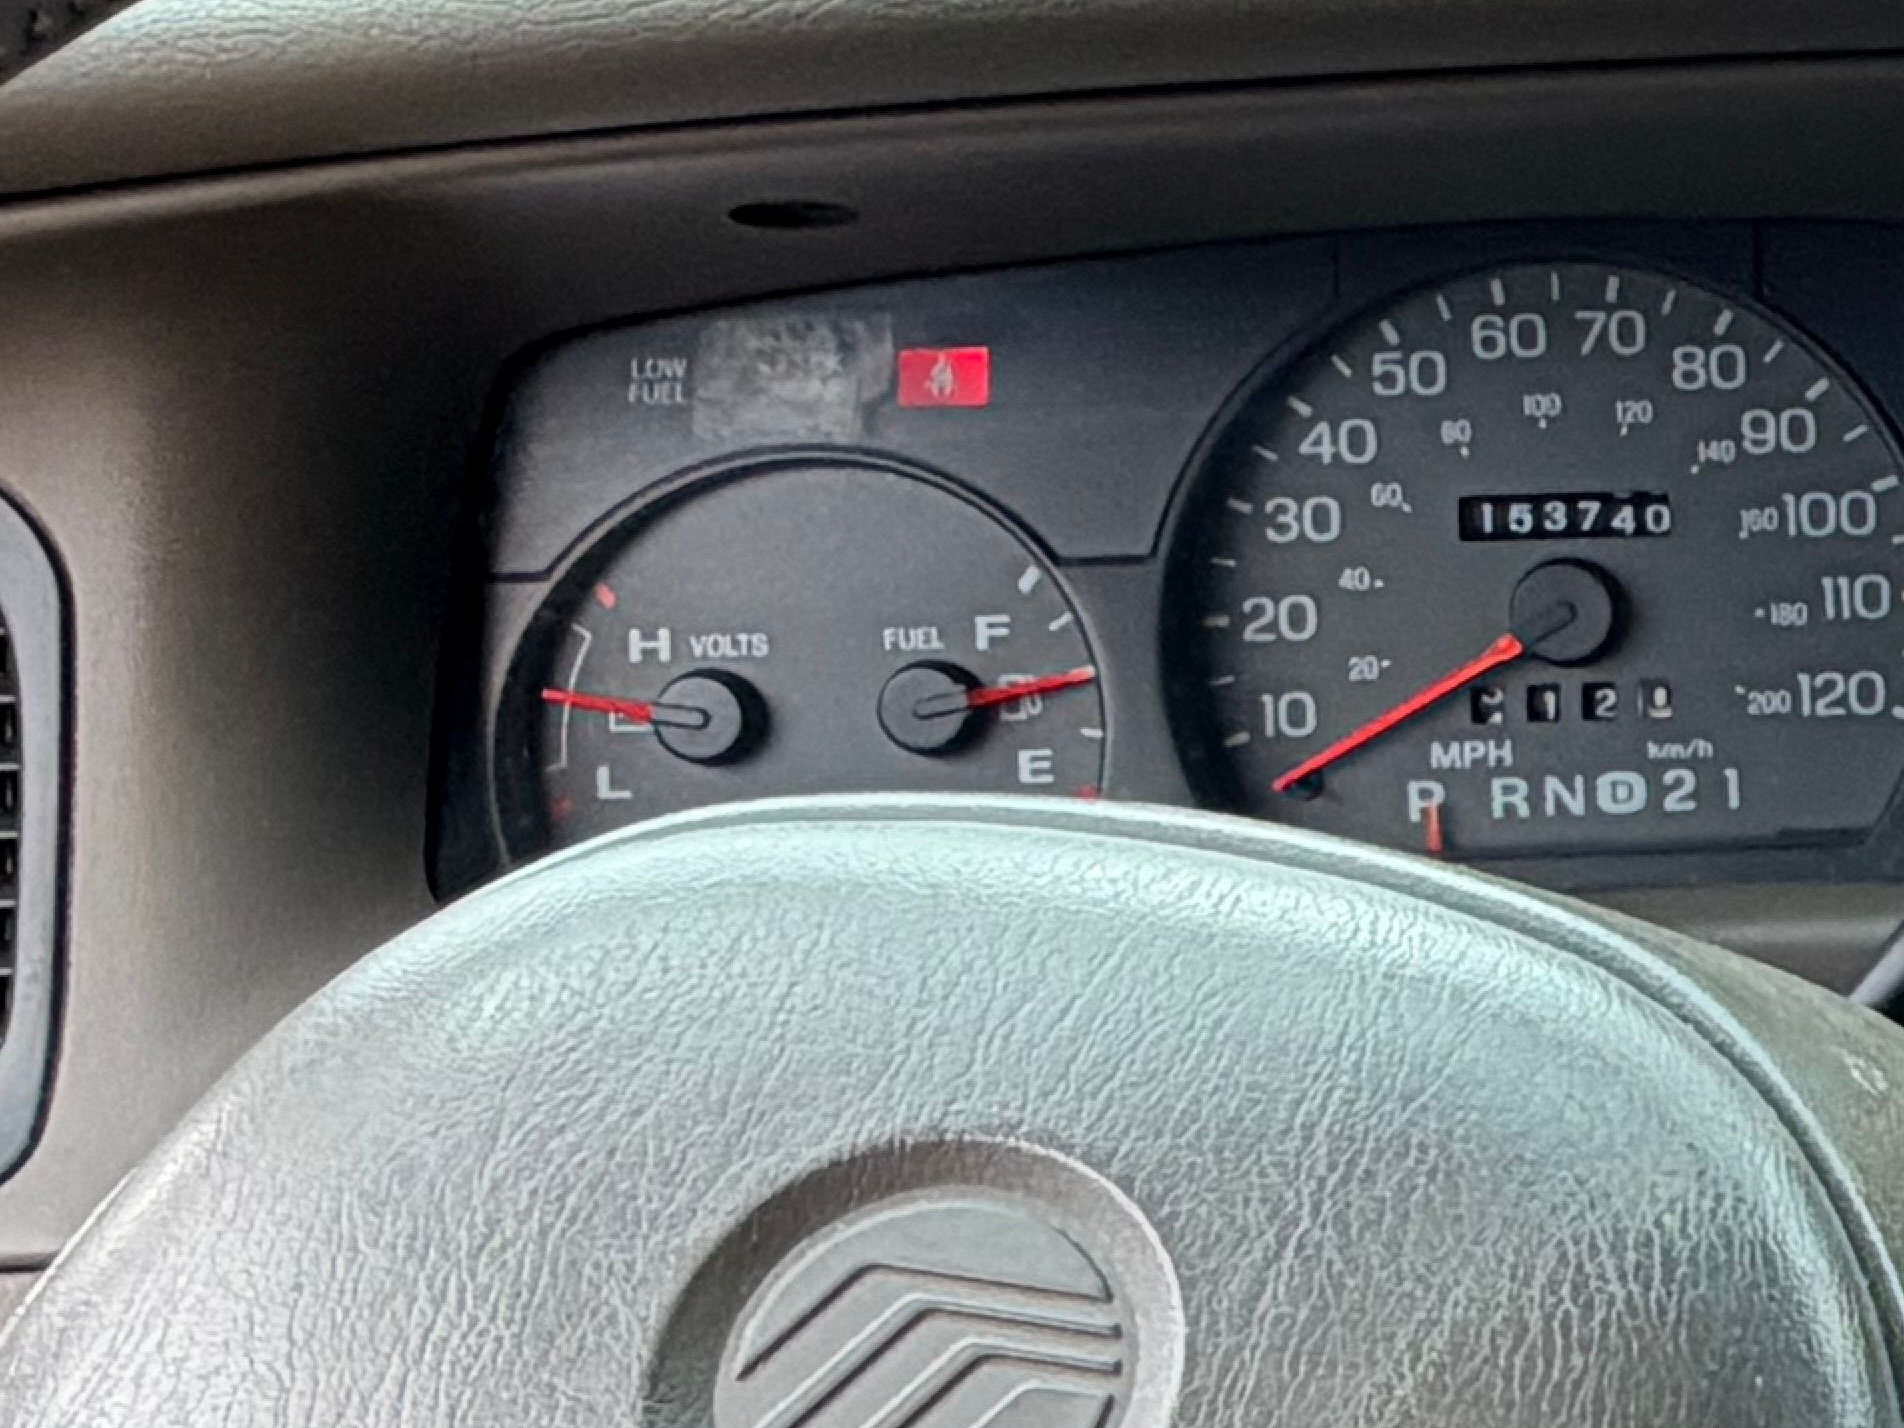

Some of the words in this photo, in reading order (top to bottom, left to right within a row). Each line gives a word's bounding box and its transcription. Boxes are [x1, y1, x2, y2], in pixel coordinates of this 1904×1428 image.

[1471, 314, 1545, 358] 60
[1576, 311, 1645, 355] 70
[631, 357, 687, 380] LOW
[1372, 351, 1445, 395] 50
[1672, 346, 1746, 390] 80
[629, 383, 687, 404] FUEL
[1523, 394, 1561, 417] 100
[1616, 401, 1652, 423] 120
[1300, 419, 1377, 464] 40
[1741, 409, 1816, 453] 90
[1699, 440, 1736, 462] 140
[1371, 485, 1401, 508] 60
[1265, 498, 1340, 543] 30
[1784, 491, 1877, 536] 100
[1338, 568, 1370, 590] 40
[1821, 575, 1890, 619] 110
[1242, 597, 1317, 641] 20
[1770, 603, 1807, 626] 180
[630, 630, 670, 661] H
[690, 632, 767, 657] VOLTS
[884, 627, 942, 651] FUEL
[975, 616, 1009, 650] F
[1348, 657, 1378, 680] 20
[1748, 691, 1790, 713] 200
[1800, 672, 1885, 716] 120
[1261, 692, 1317, 737] 10
[1431, 742, 1512, 767] MPH
[1647, 739, 1713, 758] km/h
[1018, 751, 1053, 783] E
[597, 767, 631, 800] L
